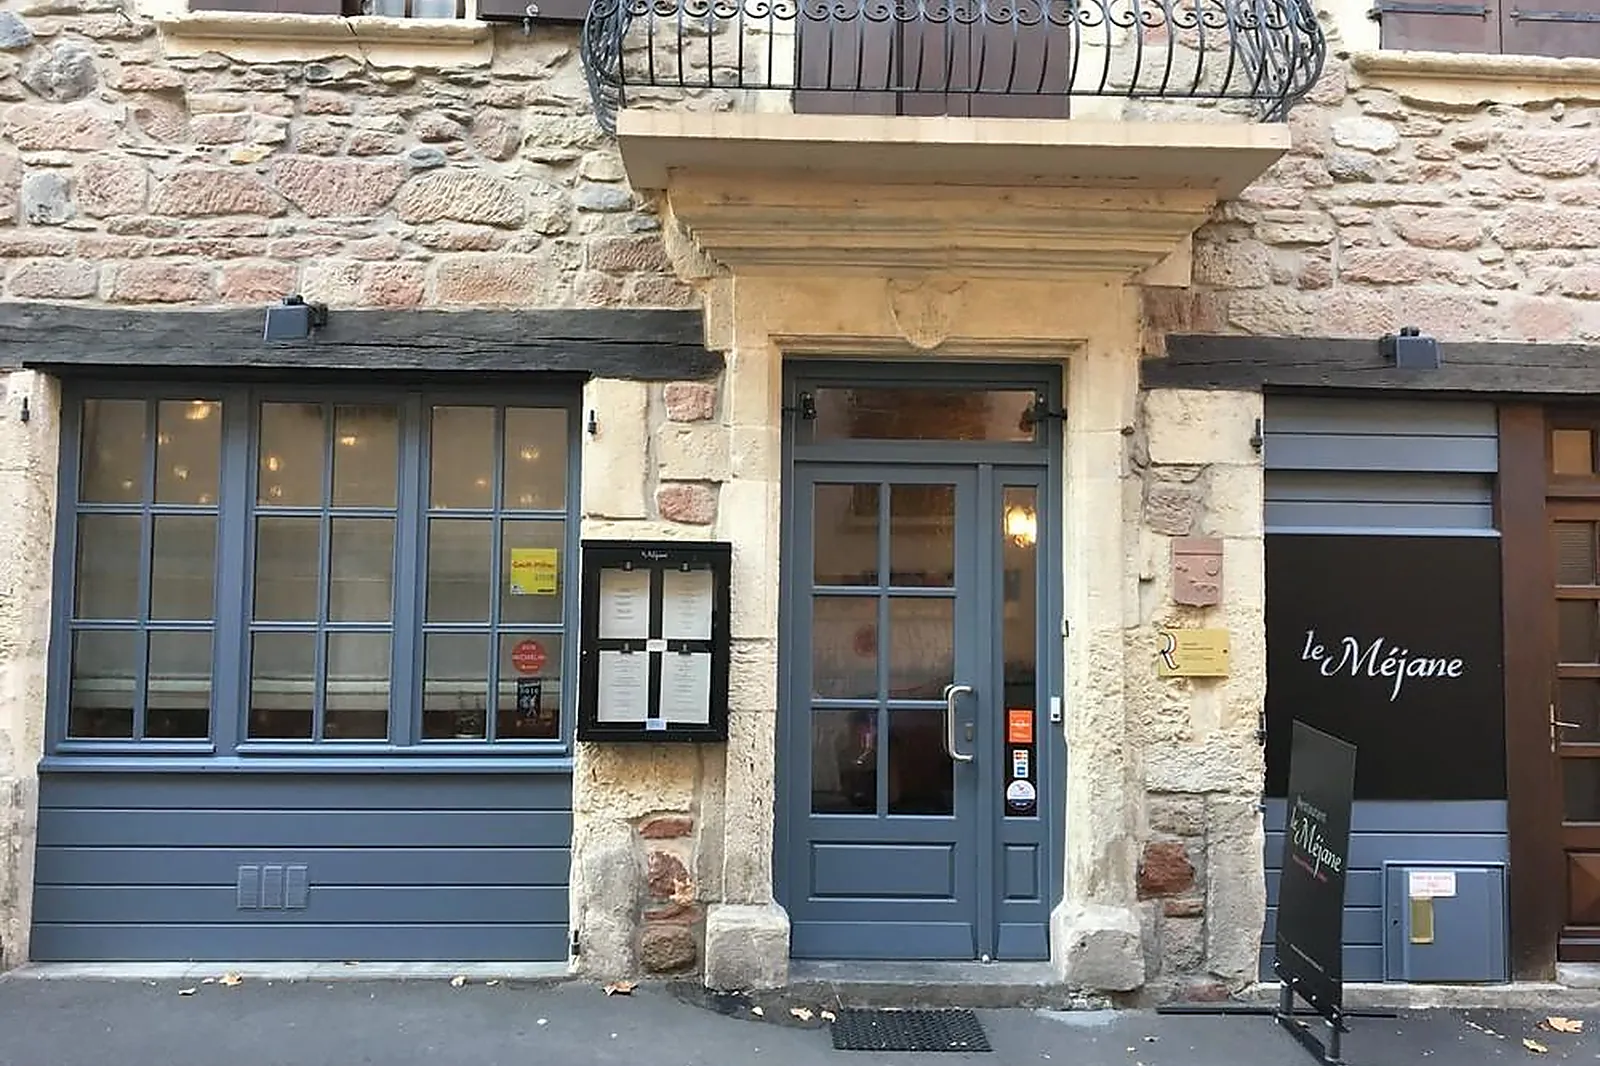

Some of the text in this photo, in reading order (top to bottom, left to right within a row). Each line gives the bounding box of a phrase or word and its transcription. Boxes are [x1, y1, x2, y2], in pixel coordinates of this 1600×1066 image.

[1302, 630, 1464, 702] le Méjane
[1293, 817, 1342, 878] Méjane
